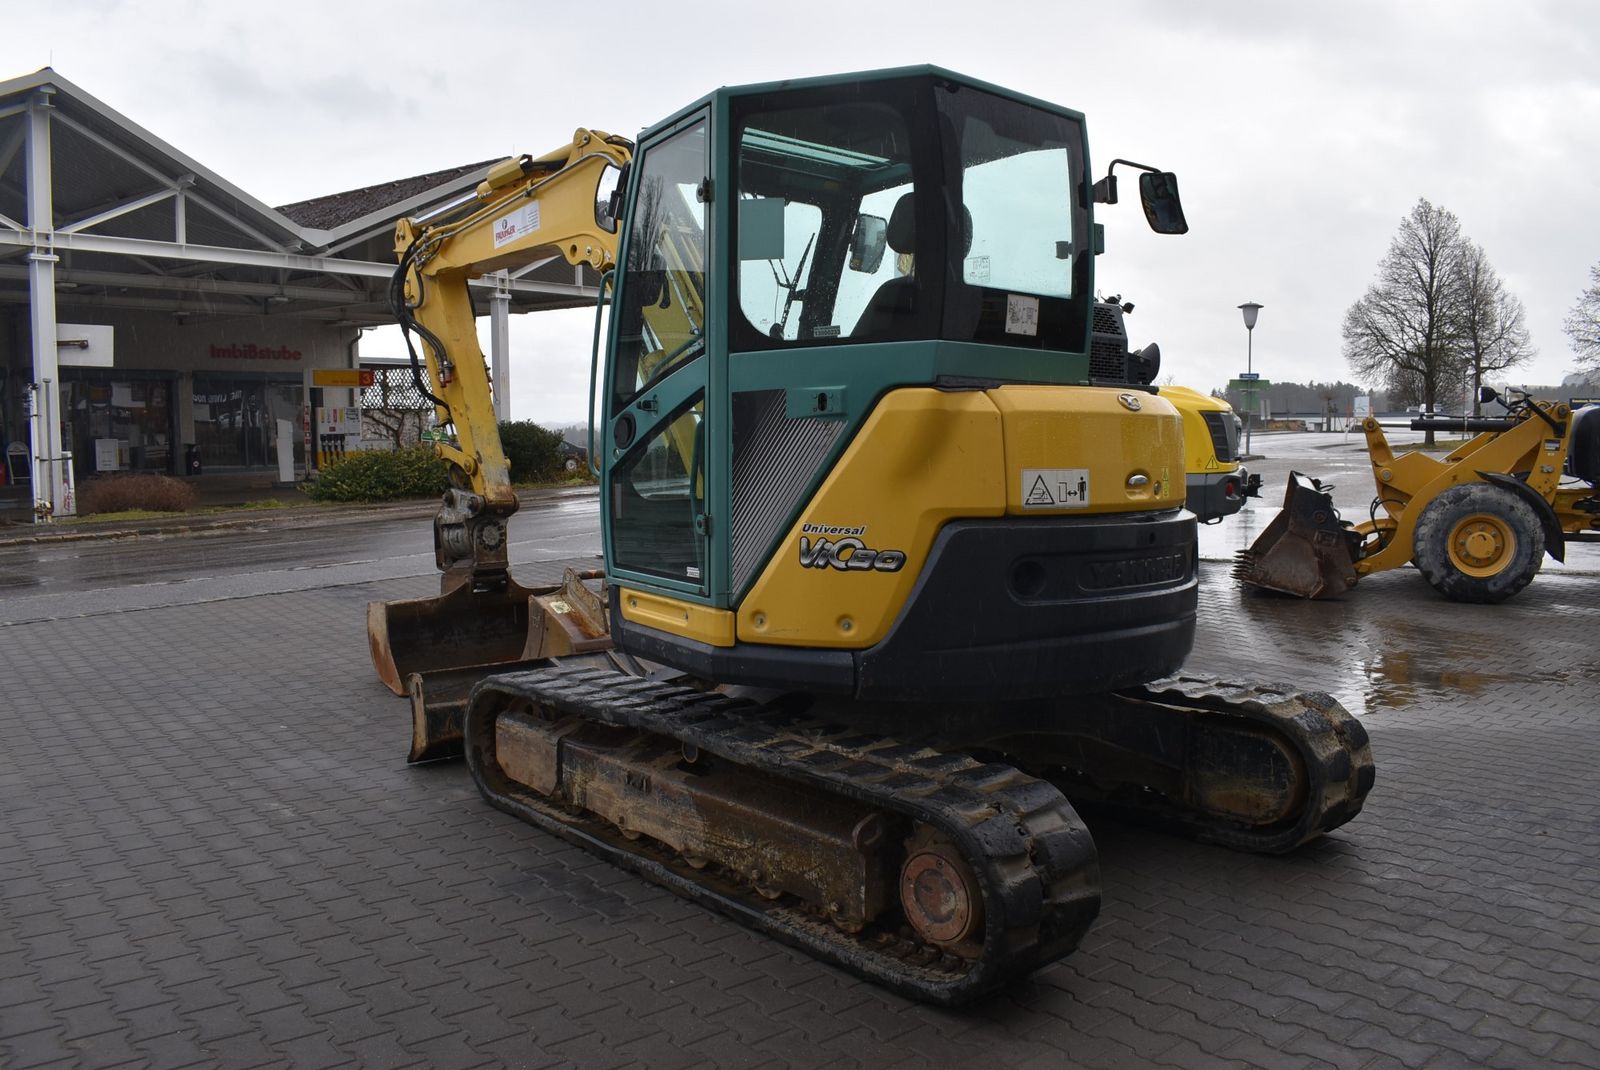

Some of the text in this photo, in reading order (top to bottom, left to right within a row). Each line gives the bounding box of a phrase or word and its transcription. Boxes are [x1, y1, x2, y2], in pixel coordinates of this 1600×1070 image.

[210, 344, 302, 360] Imbißstube
[362, 373, 371, 385] 3
[802, 522, 867, 536] Universal
